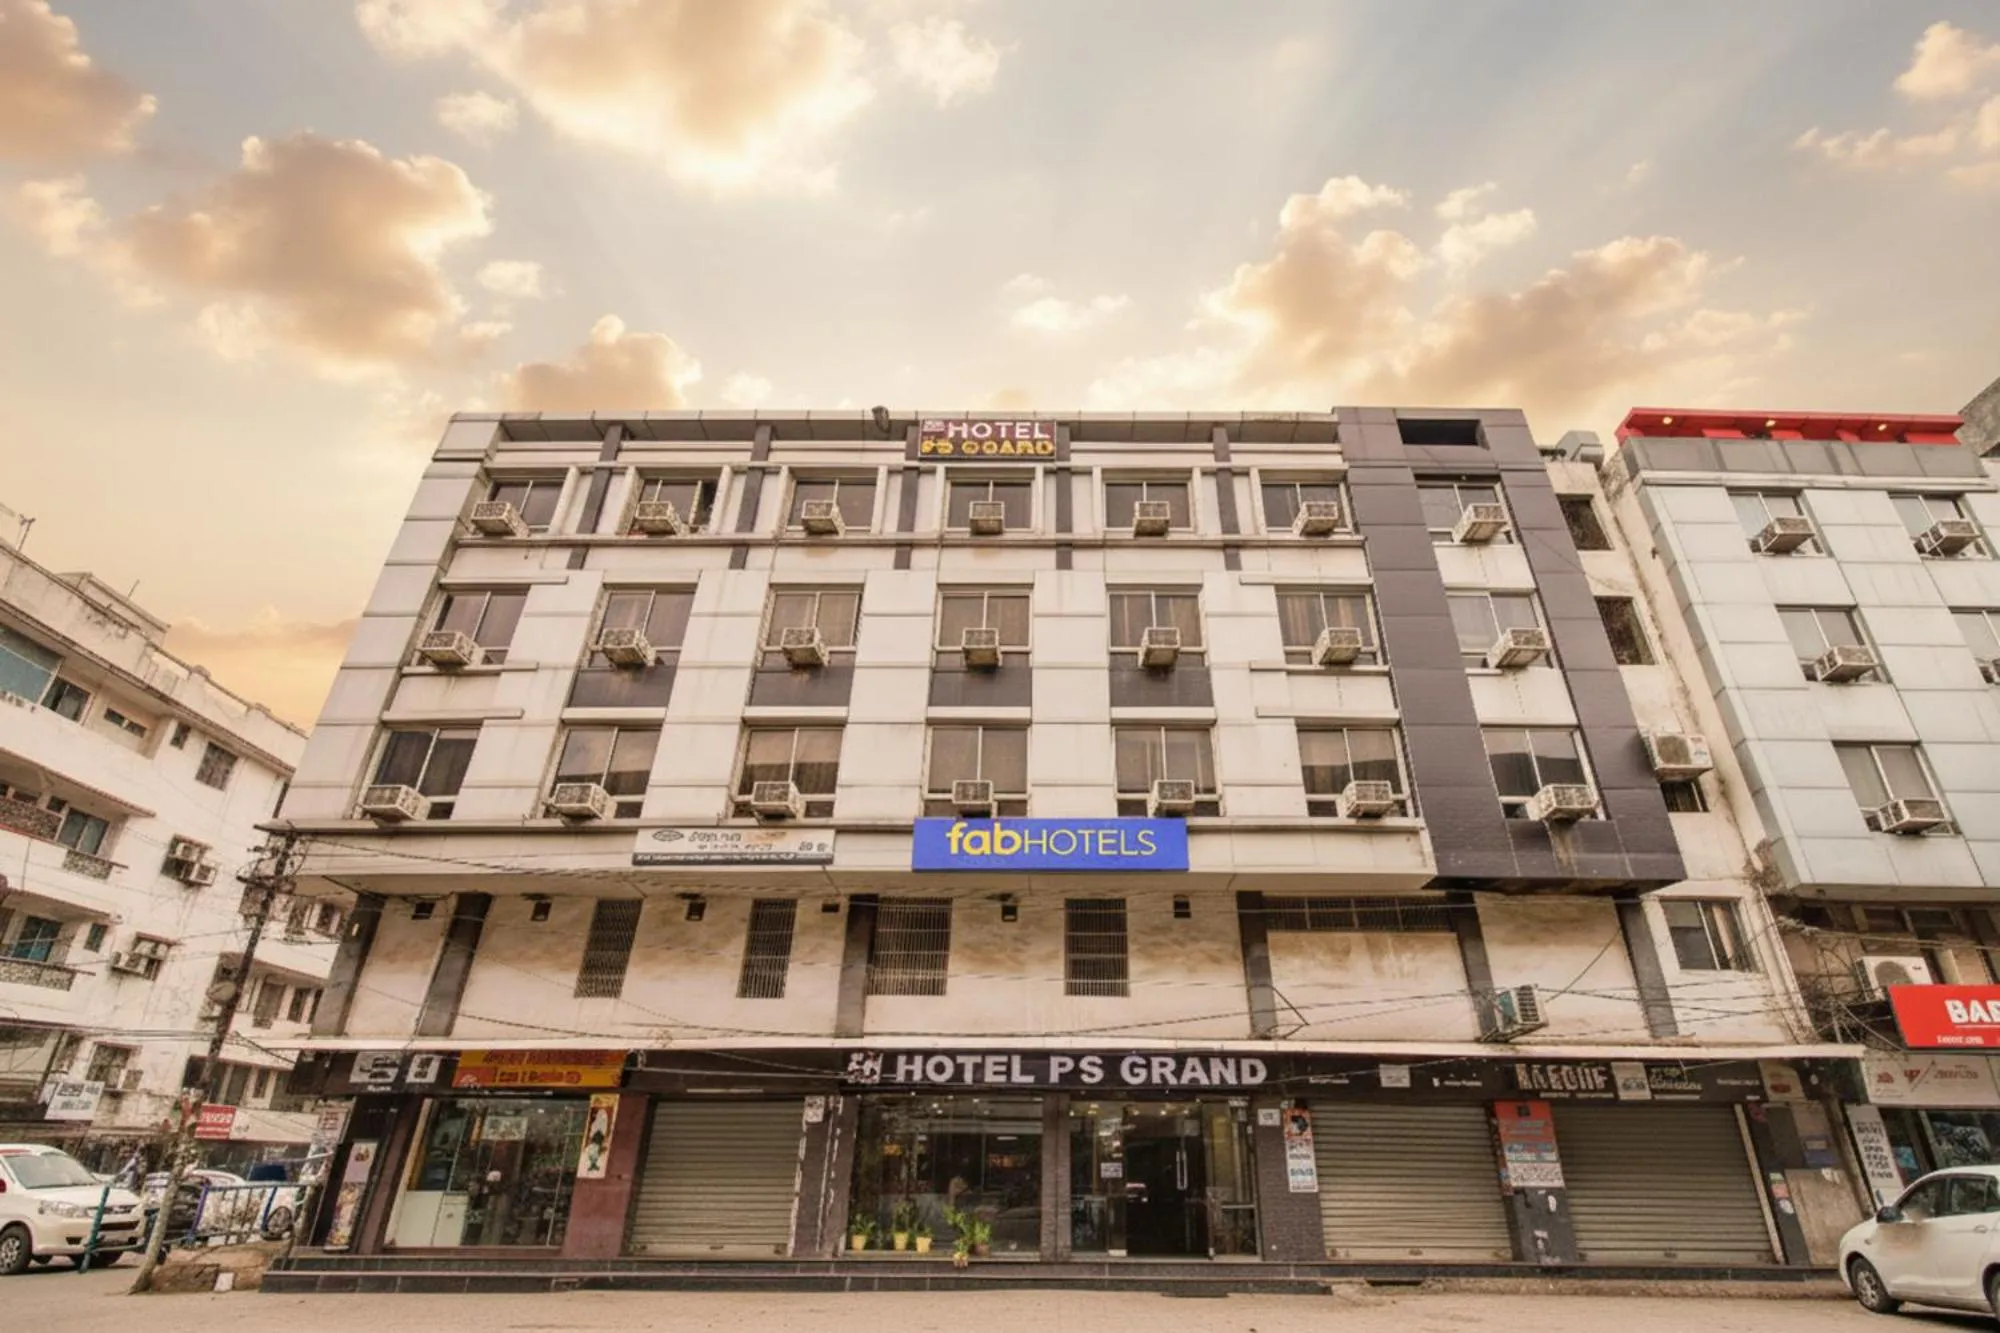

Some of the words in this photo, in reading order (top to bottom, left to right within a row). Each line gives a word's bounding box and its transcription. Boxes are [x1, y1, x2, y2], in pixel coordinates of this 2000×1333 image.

[947, 422, 1051, 439] HOTEL
[946, 822, 1158, 856] fabHOTELS
[896, 1055, 1034, 1084] HOTEL
[1049, 1056, 1105, 1084] PS
[1119, 1056, 1268, 1085] GRAND
